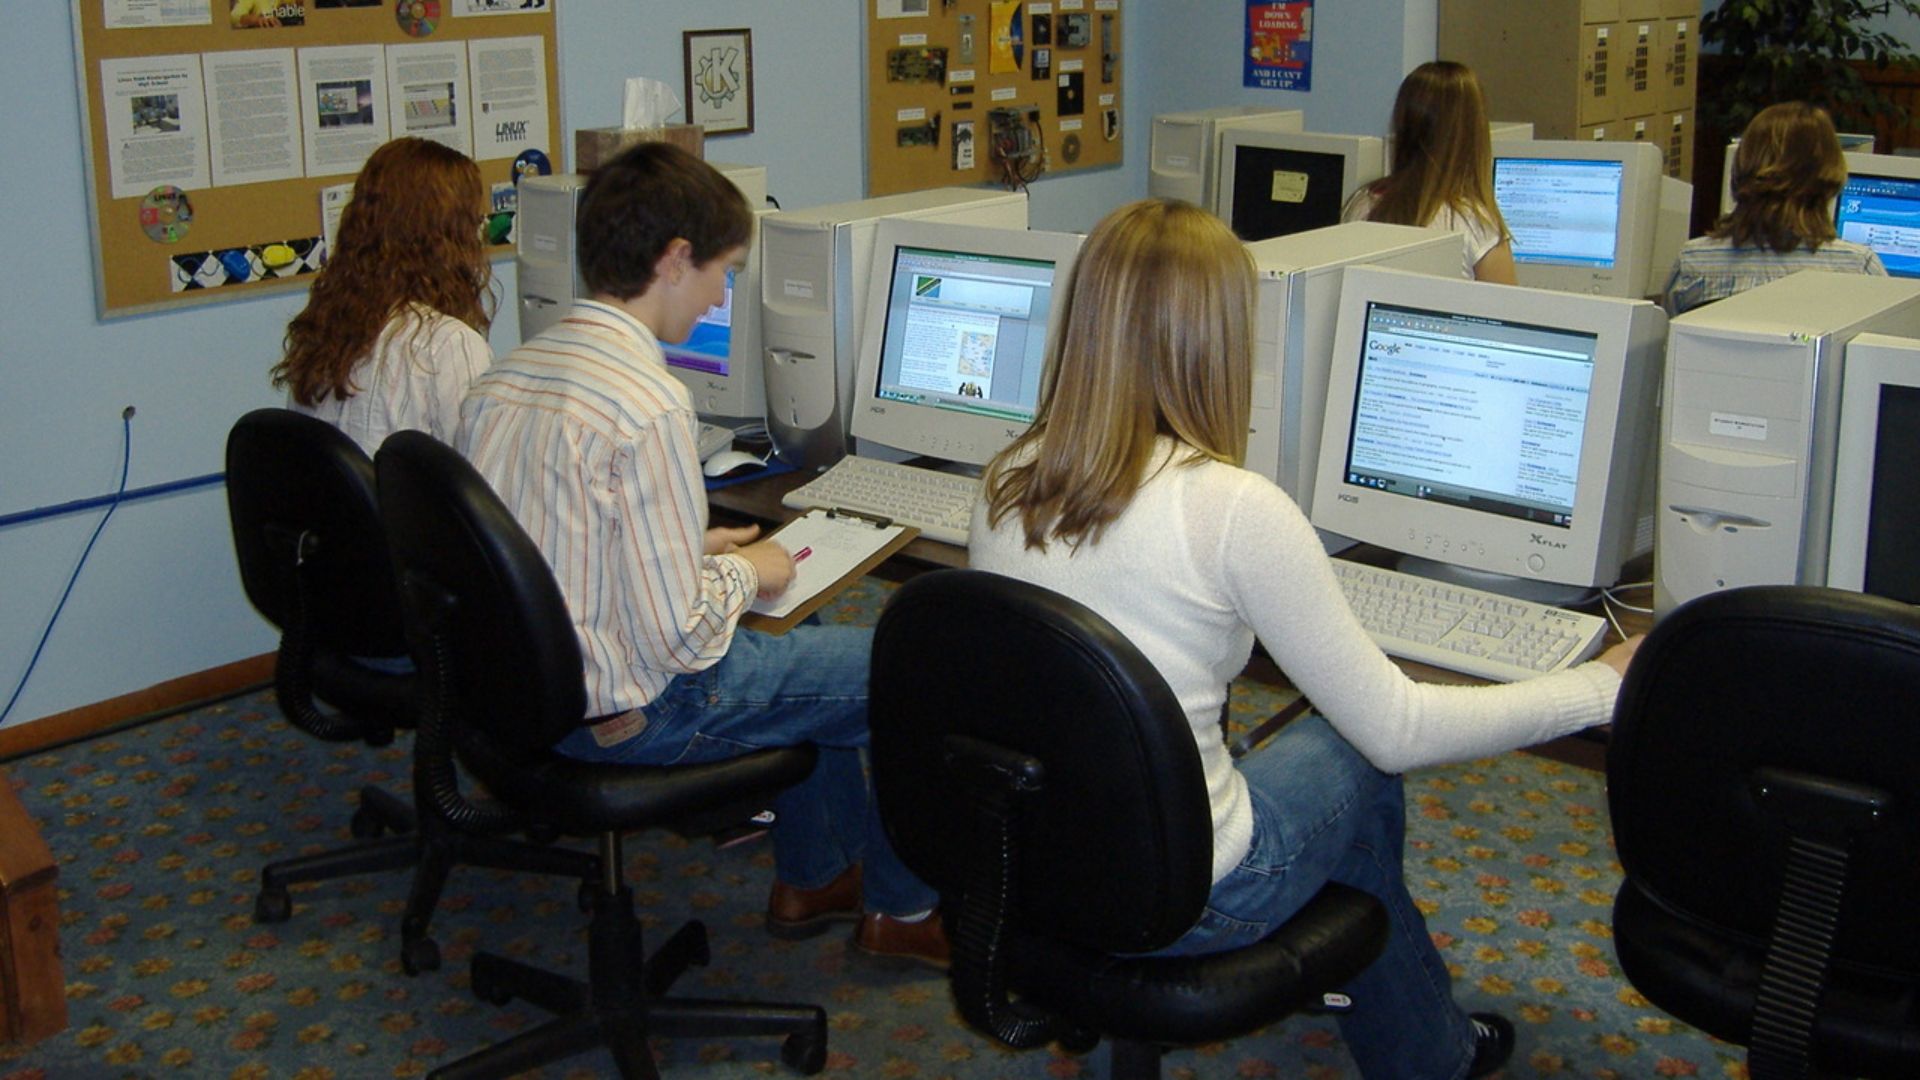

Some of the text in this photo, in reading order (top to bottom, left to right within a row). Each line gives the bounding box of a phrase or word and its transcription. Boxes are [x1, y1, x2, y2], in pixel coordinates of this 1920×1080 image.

[1264, 11, 1291, 19] DOWN
[1259, 20, 1298, 30] LOADING
[1253, 69, 1271, 78] AND
[1277, 71, 1303, 80] CAN'T
[1260, 79, 1278, 87] GET
[496, 121, 526, 136] LINUX
[1369, 340, 1401, 356] Google
